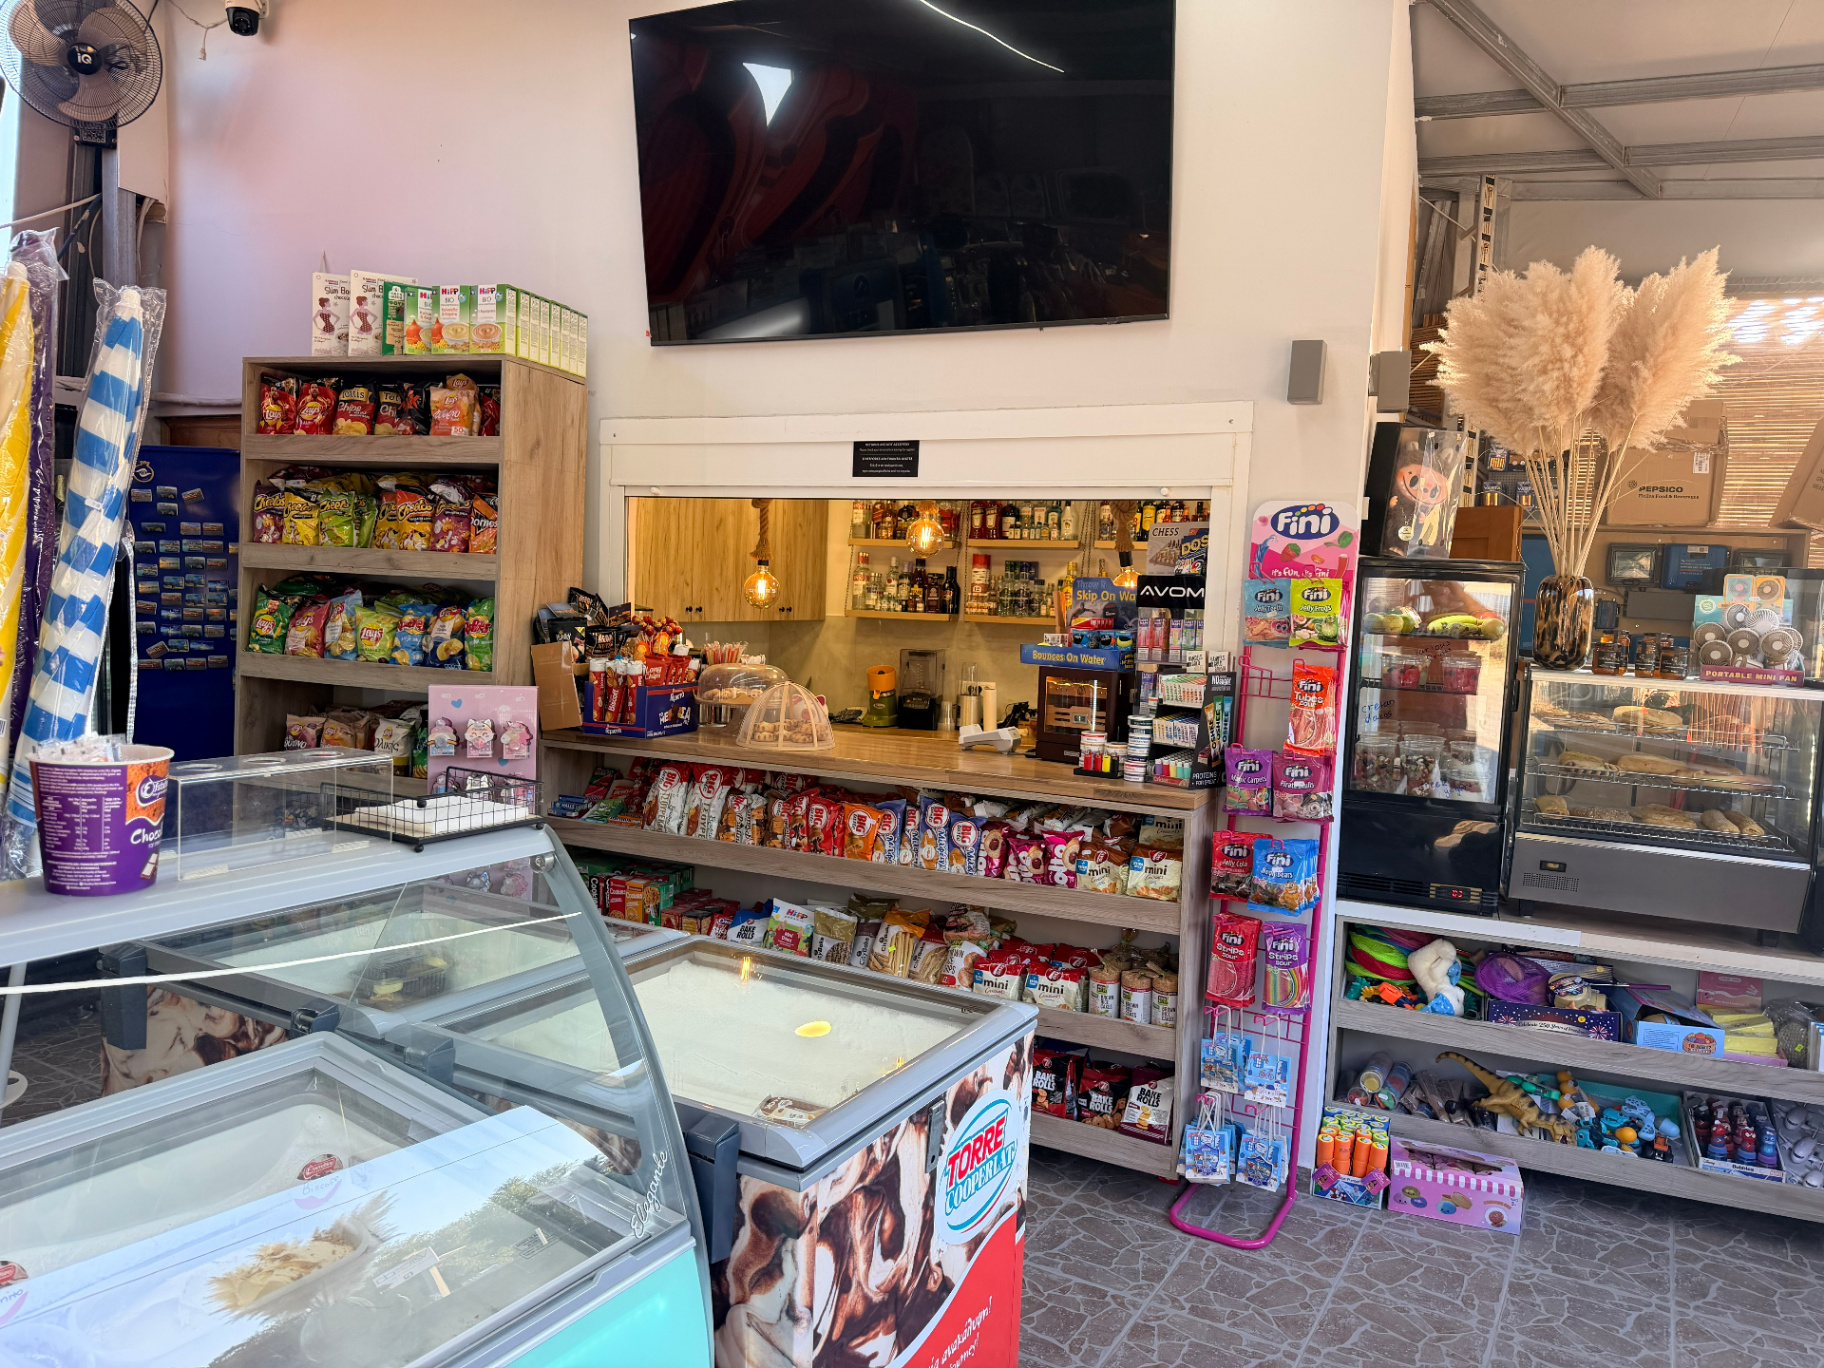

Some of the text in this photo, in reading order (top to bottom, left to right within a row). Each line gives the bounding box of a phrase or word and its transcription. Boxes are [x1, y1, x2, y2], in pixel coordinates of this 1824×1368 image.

[77, 52, 92, 65] iQ
[1277, 503, 1333, 536] Fini
[1152, 527, 1179, 537] CHESS
[1077, 590, 1098, 602] Skip
[1101, 590, 1116, 601] On
[1033, 650, 1065, 662] Bounces
[1066, 652, 1079, 663] On
[1080, 653, 1106, 666] Water
[1705, 669, 1799, 682] PORTABLE MINI FAN
[1294, 691, 1324, 704] Tubes
[1224, 844, 1248, 859] Fini
[1266, 852, 1292, 867] Fini
[1088, 866, 1111, 877] mini
[1145, 864, 1167, 876] mini
[786, 908, 808, 919] HiPP
[740, 924, 756, 934] BAKE
[736, 931, 755, 940] ROLLS
[1216, 943, 1245, 957] Strips
[1268, 952, 1298, 962] Strips
[983, 978, 1009, 990] mini
[1038, 983, 1065, 995] mini
[1035, 1070, 1056, 1082] BAKE
[1033, 1078, 1056, 1091] ROLLS
[1139, 1087, 1162, 1099] BAKE
[1091, 1095, 1113, 1106] BAKE
[1136, 1095, 1160, 1108] ROLLS
[1089, 1102, 1113, 1114] ROLLS
[946, 1115, 1006, 1189] TORRE
[944, 1141, 1017, 1217] COOPERLAT
[630, 1150, 668, 1239] Elegante
